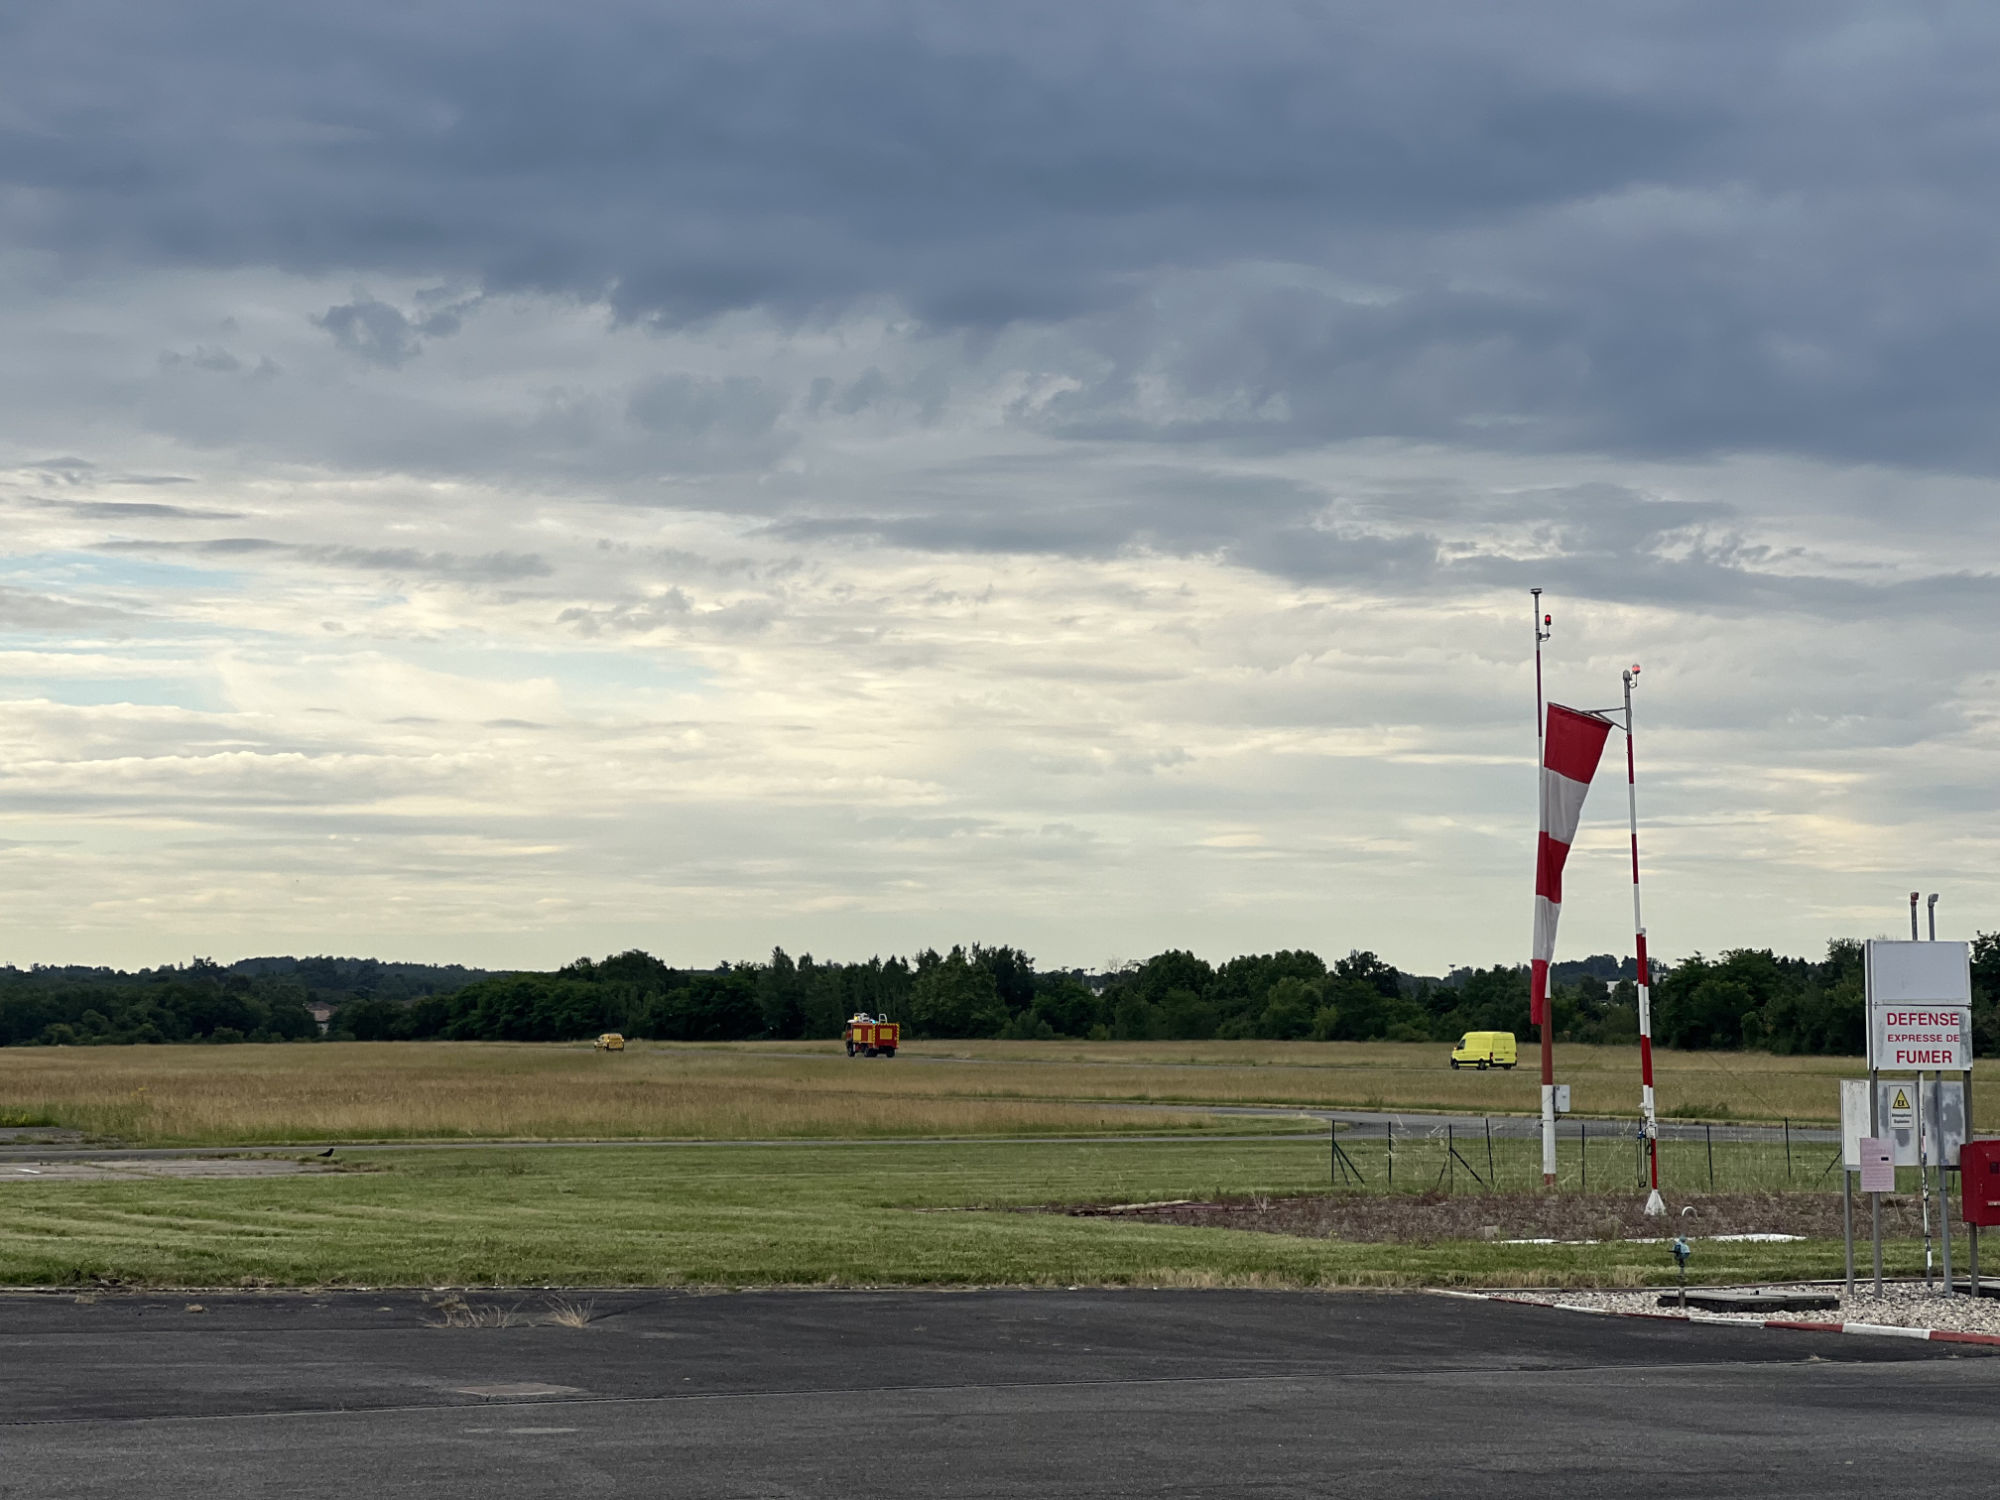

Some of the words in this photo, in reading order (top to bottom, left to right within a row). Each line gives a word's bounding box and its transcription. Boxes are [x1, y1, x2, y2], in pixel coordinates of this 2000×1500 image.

[1887, 1012, 1960, 1026] DEFENSE
[1888, 1034, 1943, 1042] EXPRESSE
[1946, 1034, 1960, 1042] DE
[1896, 1050, 1953, 1063] FUMER
